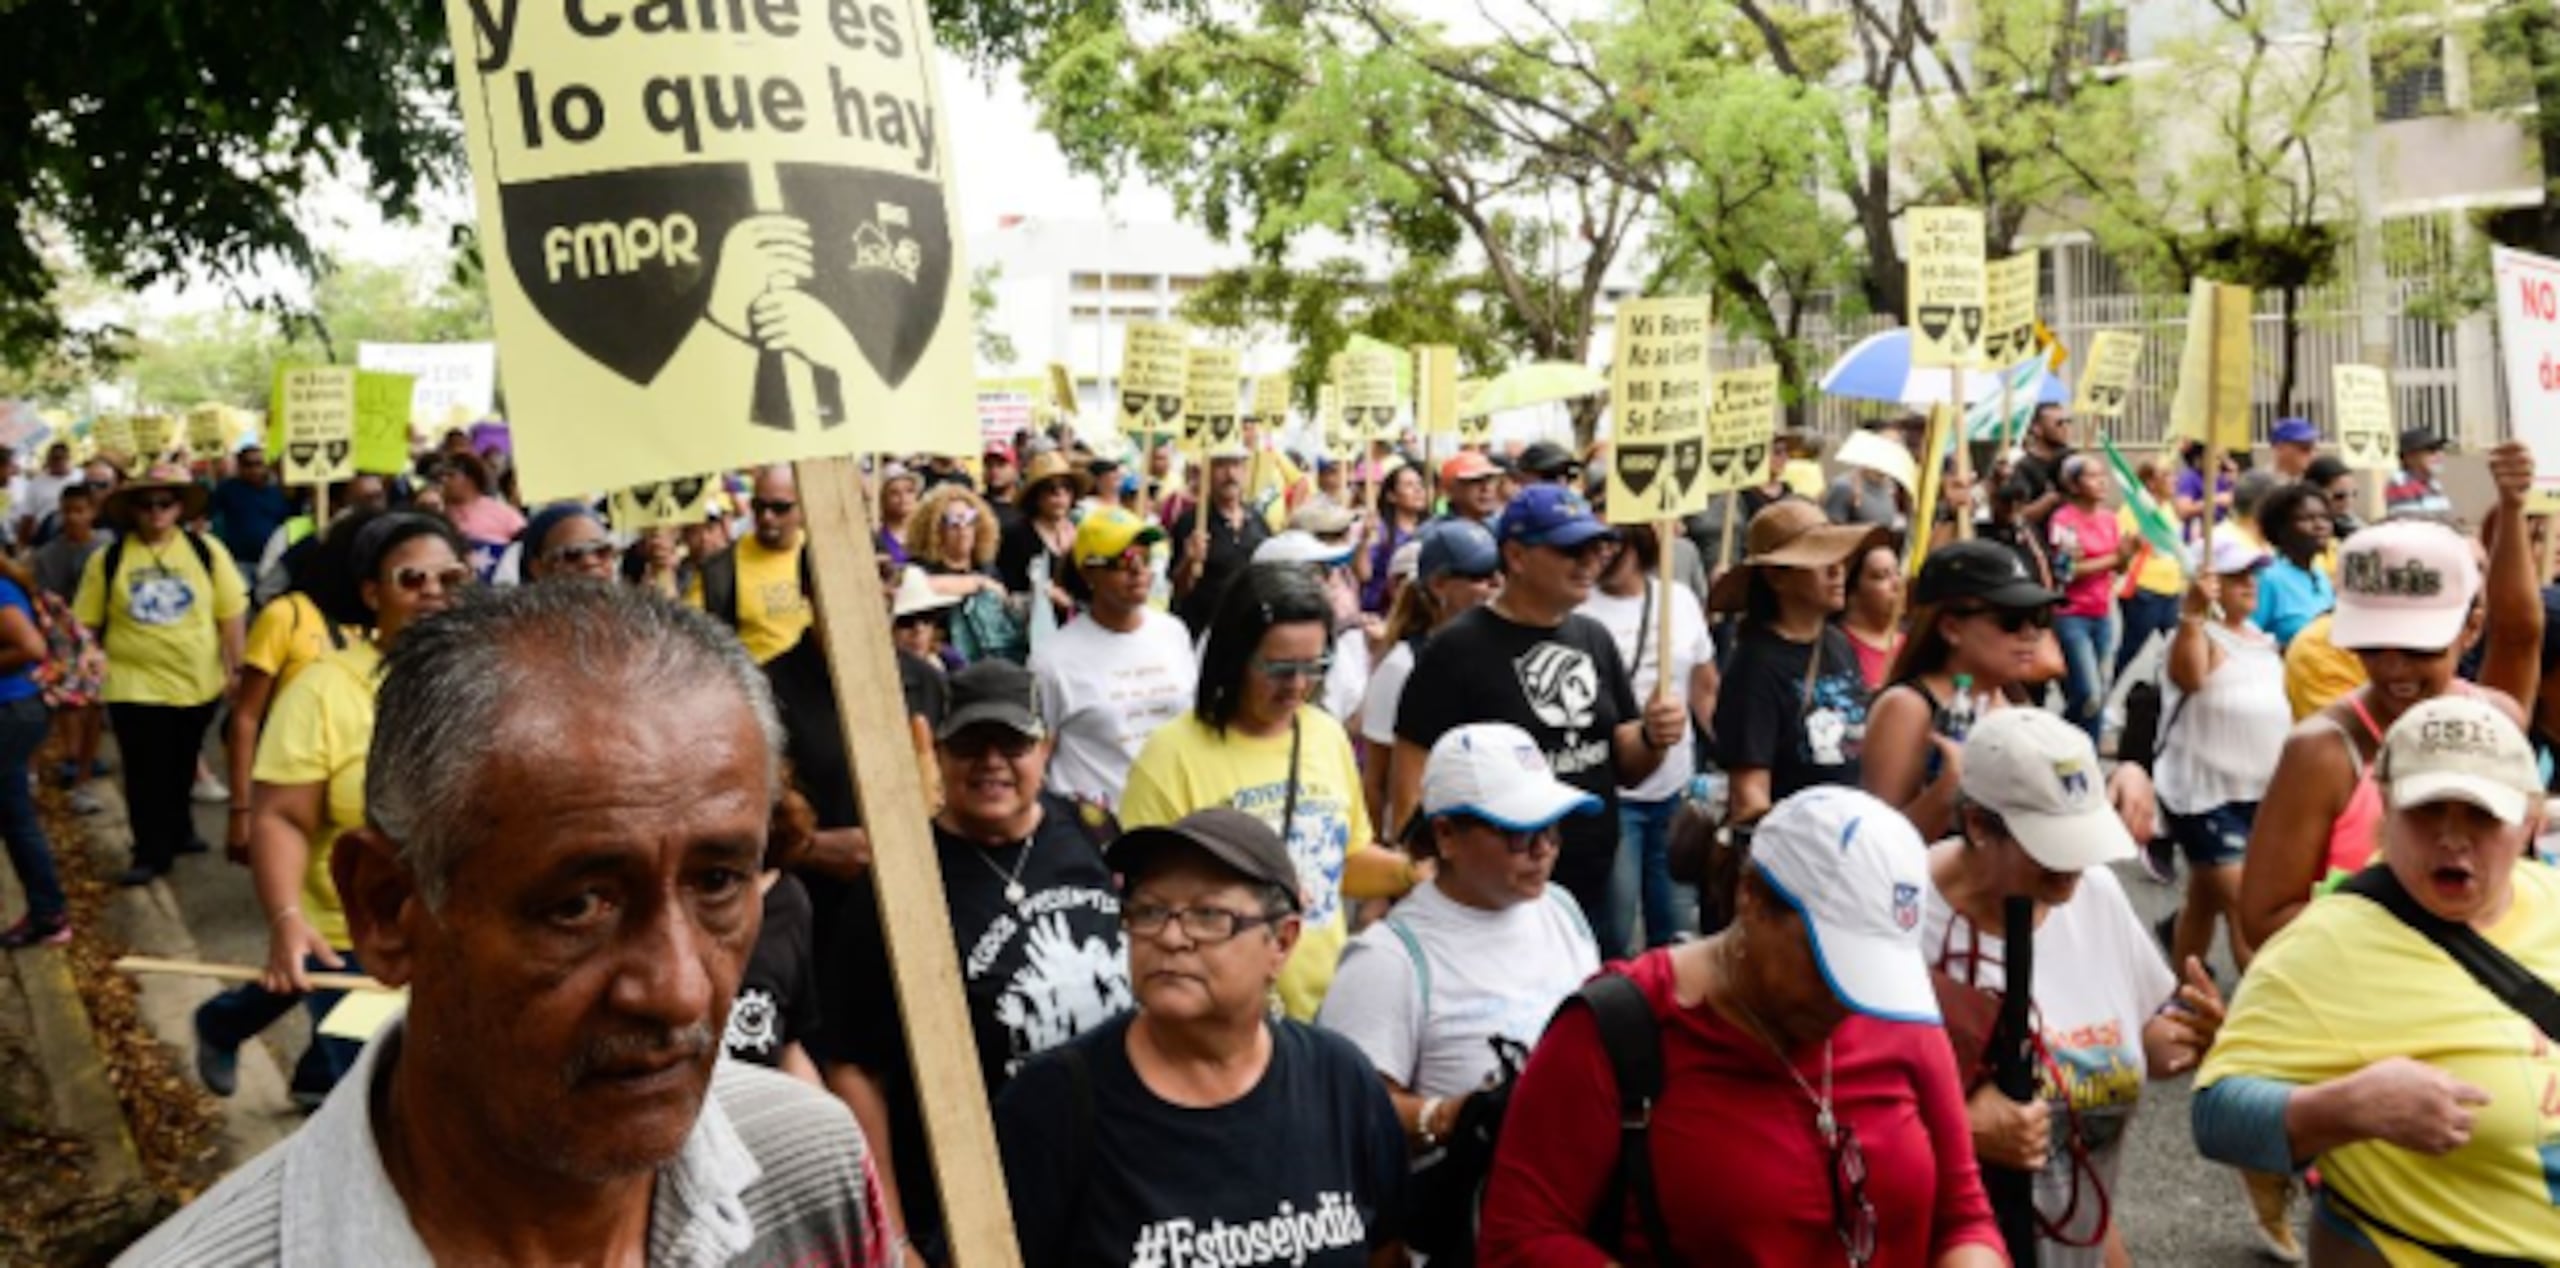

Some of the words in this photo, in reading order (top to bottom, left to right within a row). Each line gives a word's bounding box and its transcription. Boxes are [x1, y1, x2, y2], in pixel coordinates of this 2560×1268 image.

[467, 0, 518, 74] y
[828, 0, 903, 58] es
[515, 69, 605, 149] lo
[643, 73, 806, 153] que
[828, 63, 936, 171] hay
[543, 211, 700, 283] FMPR
[2520, 277, 2556, 321] NO
[2539, 350, 2560, 390] d
